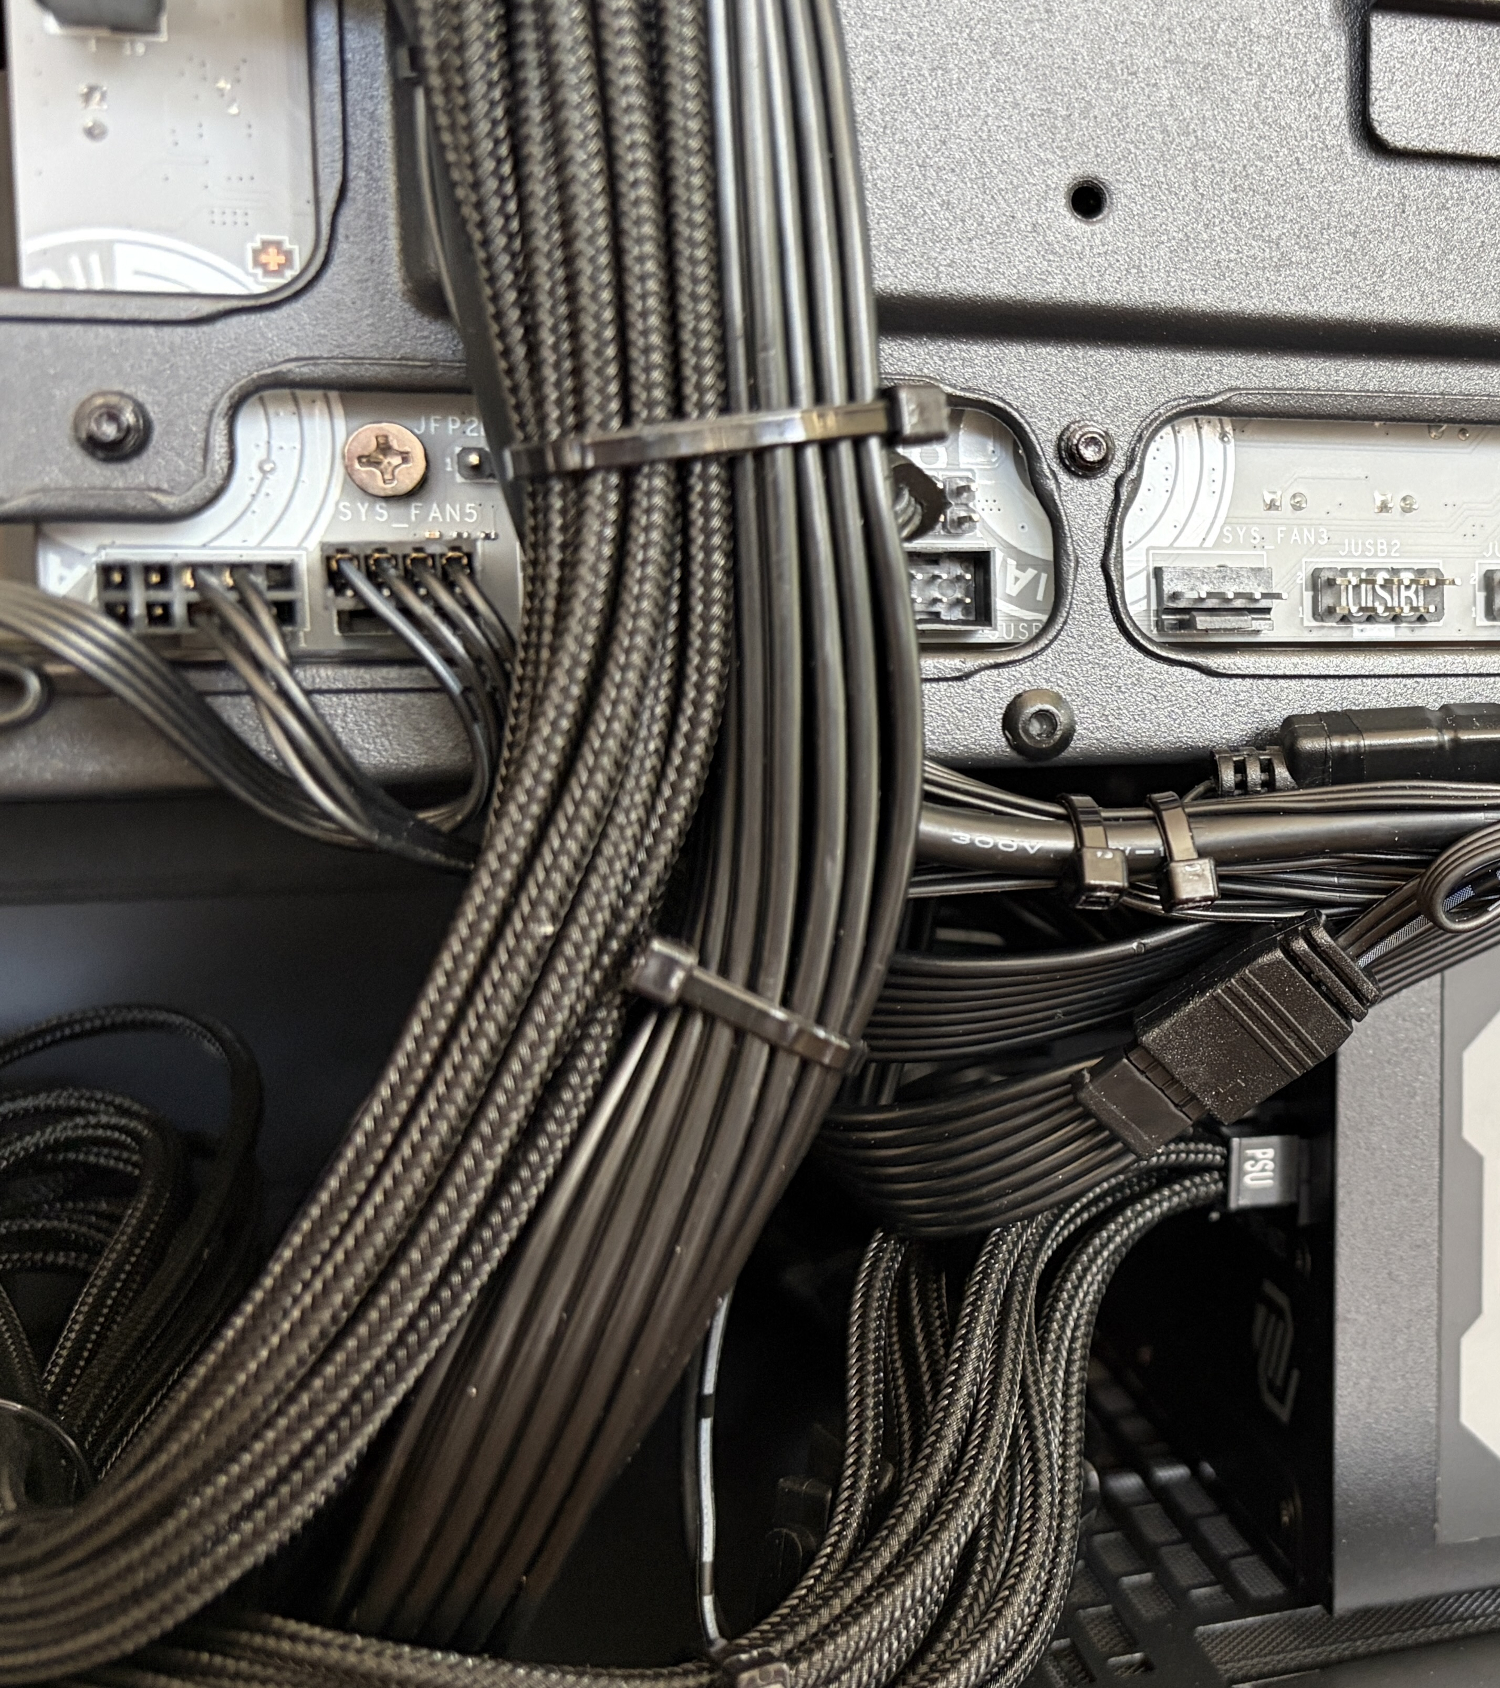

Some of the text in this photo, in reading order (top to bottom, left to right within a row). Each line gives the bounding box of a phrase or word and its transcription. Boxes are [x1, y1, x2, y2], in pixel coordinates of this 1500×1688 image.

[338, 502, 478, 528] SYS_FAN5
[1222, 527, 1329, 550] SYS_FAN3
[1339, 539, 1402, 557] JUSB2
[951, 831, 1043, 855] 300V
[1242, 1147, 1275, 1189] PSU
